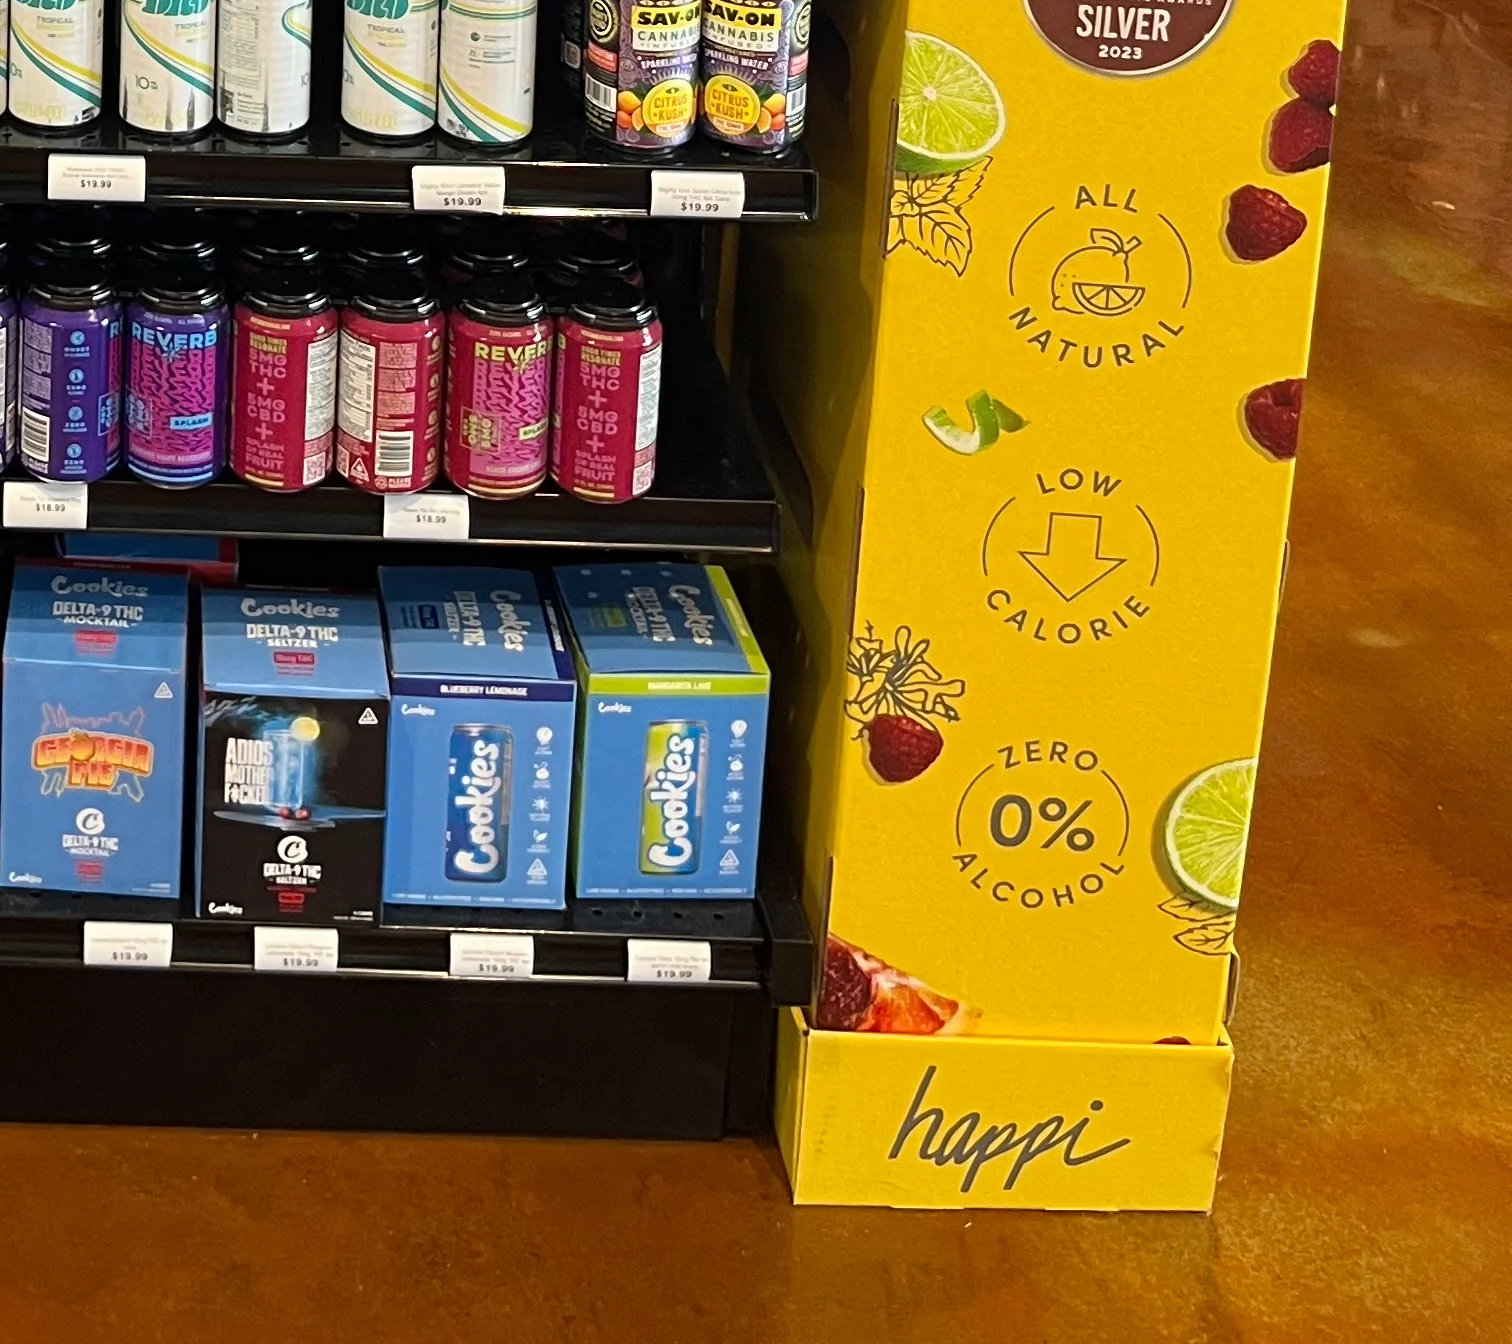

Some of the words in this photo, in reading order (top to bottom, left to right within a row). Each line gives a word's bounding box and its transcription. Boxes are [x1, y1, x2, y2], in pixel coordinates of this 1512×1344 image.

[1076, 5, 1170, 41] SILVER
[711, 90, 749, 108] CITRUS
[681, 202, 719, 212] $19.99
[1075, 184, 1137, 213] ALL
[131, 322, 217, 350] REVERB
[1009, 306, 1185, 369] NATURAL
[1036, 468, 1122, 497] LOW
[240, 598, 340, 618] Cookies
[987, 589, 1151, 644] CALORIE
[226, 738, 273, 765] ADIOS
[998, 740, 1098, 772] ZERO
[990, 794, 1096, 853] 0%
[953, 853, 1125, 908] ALCOHOL
[887, 1065, 1131, 1192] happi
